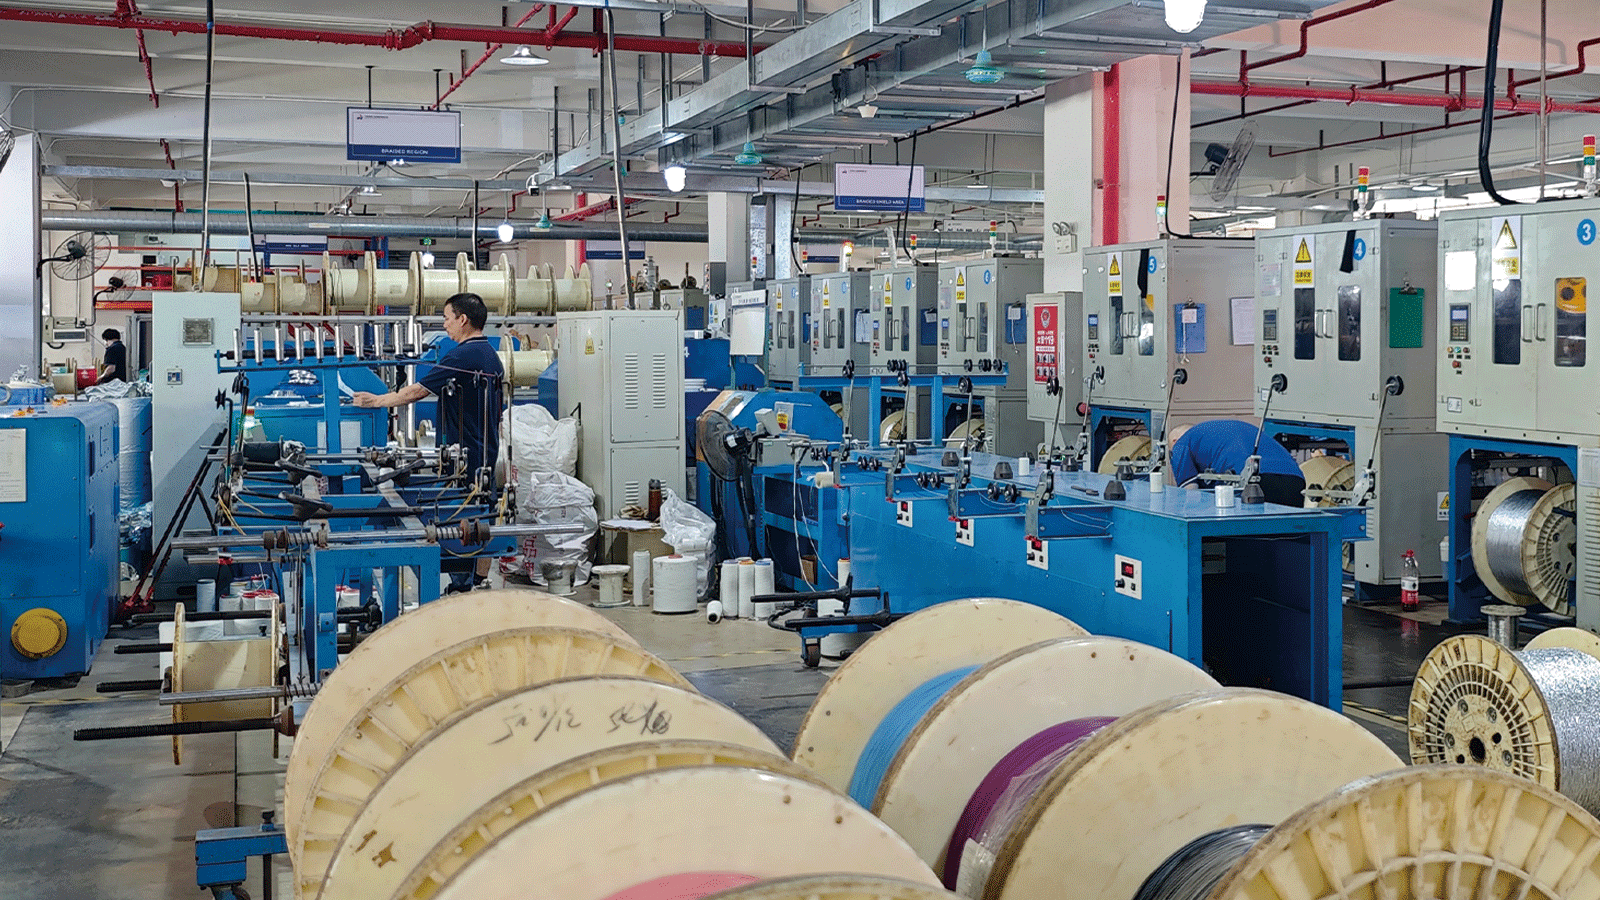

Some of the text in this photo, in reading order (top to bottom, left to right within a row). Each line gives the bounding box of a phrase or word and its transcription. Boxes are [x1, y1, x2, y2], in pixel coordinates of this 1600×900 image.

[1582, 223, 1591, 241] 3
[1355, 241, 1363, 257] 4
[1149, 258, 1155, 271] 5
